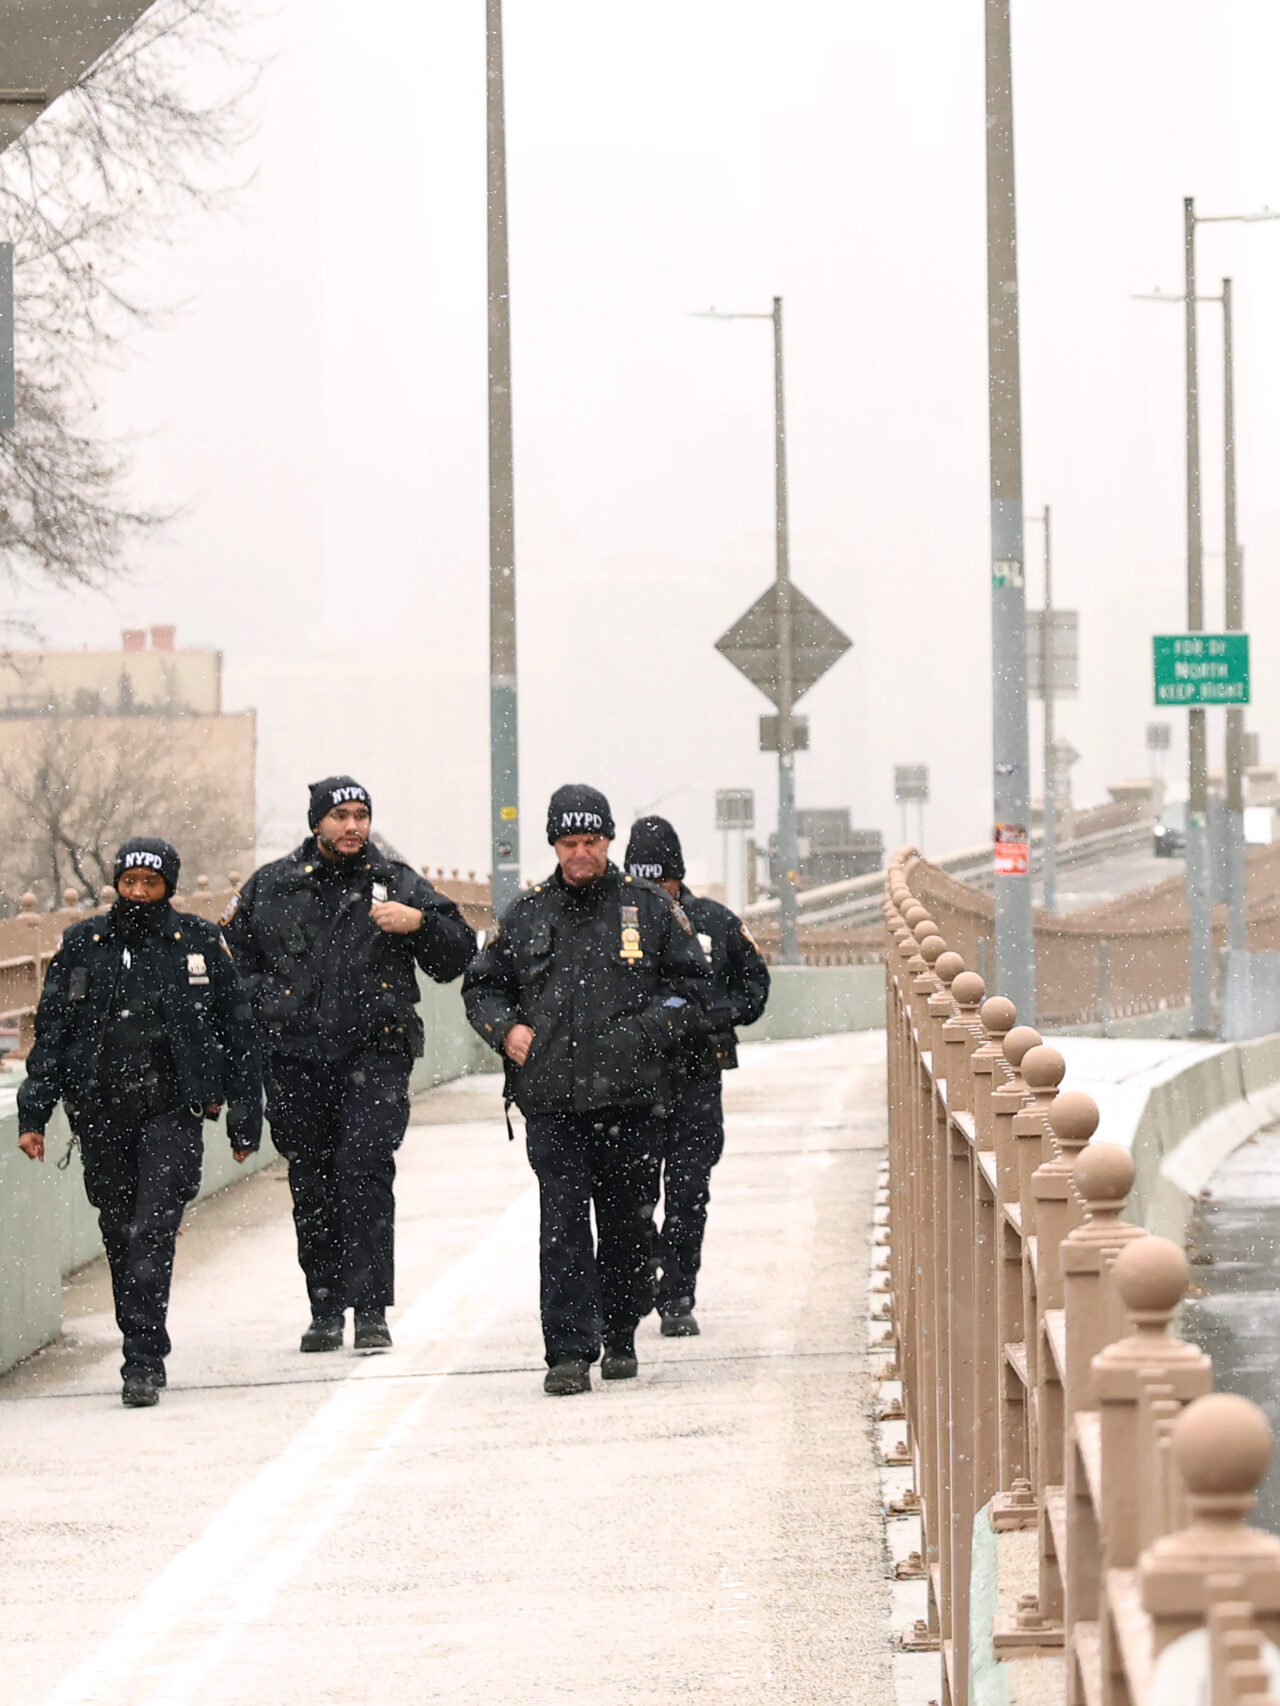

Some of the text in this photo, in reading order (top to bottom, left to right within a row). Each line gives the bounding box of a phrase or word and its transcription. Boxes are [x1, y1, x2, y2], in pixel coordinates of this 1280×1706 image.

[1174, 660, 1229, 680] NORTH
[1158, 682, 1244, 700] KEEP RIGHT
[332, 786, 366, 804] NYPD
[560, 811, 603, 828] NYPD
[125, 851, 163, 870] NYPD
[629, 863, 663, 878] NYPD
